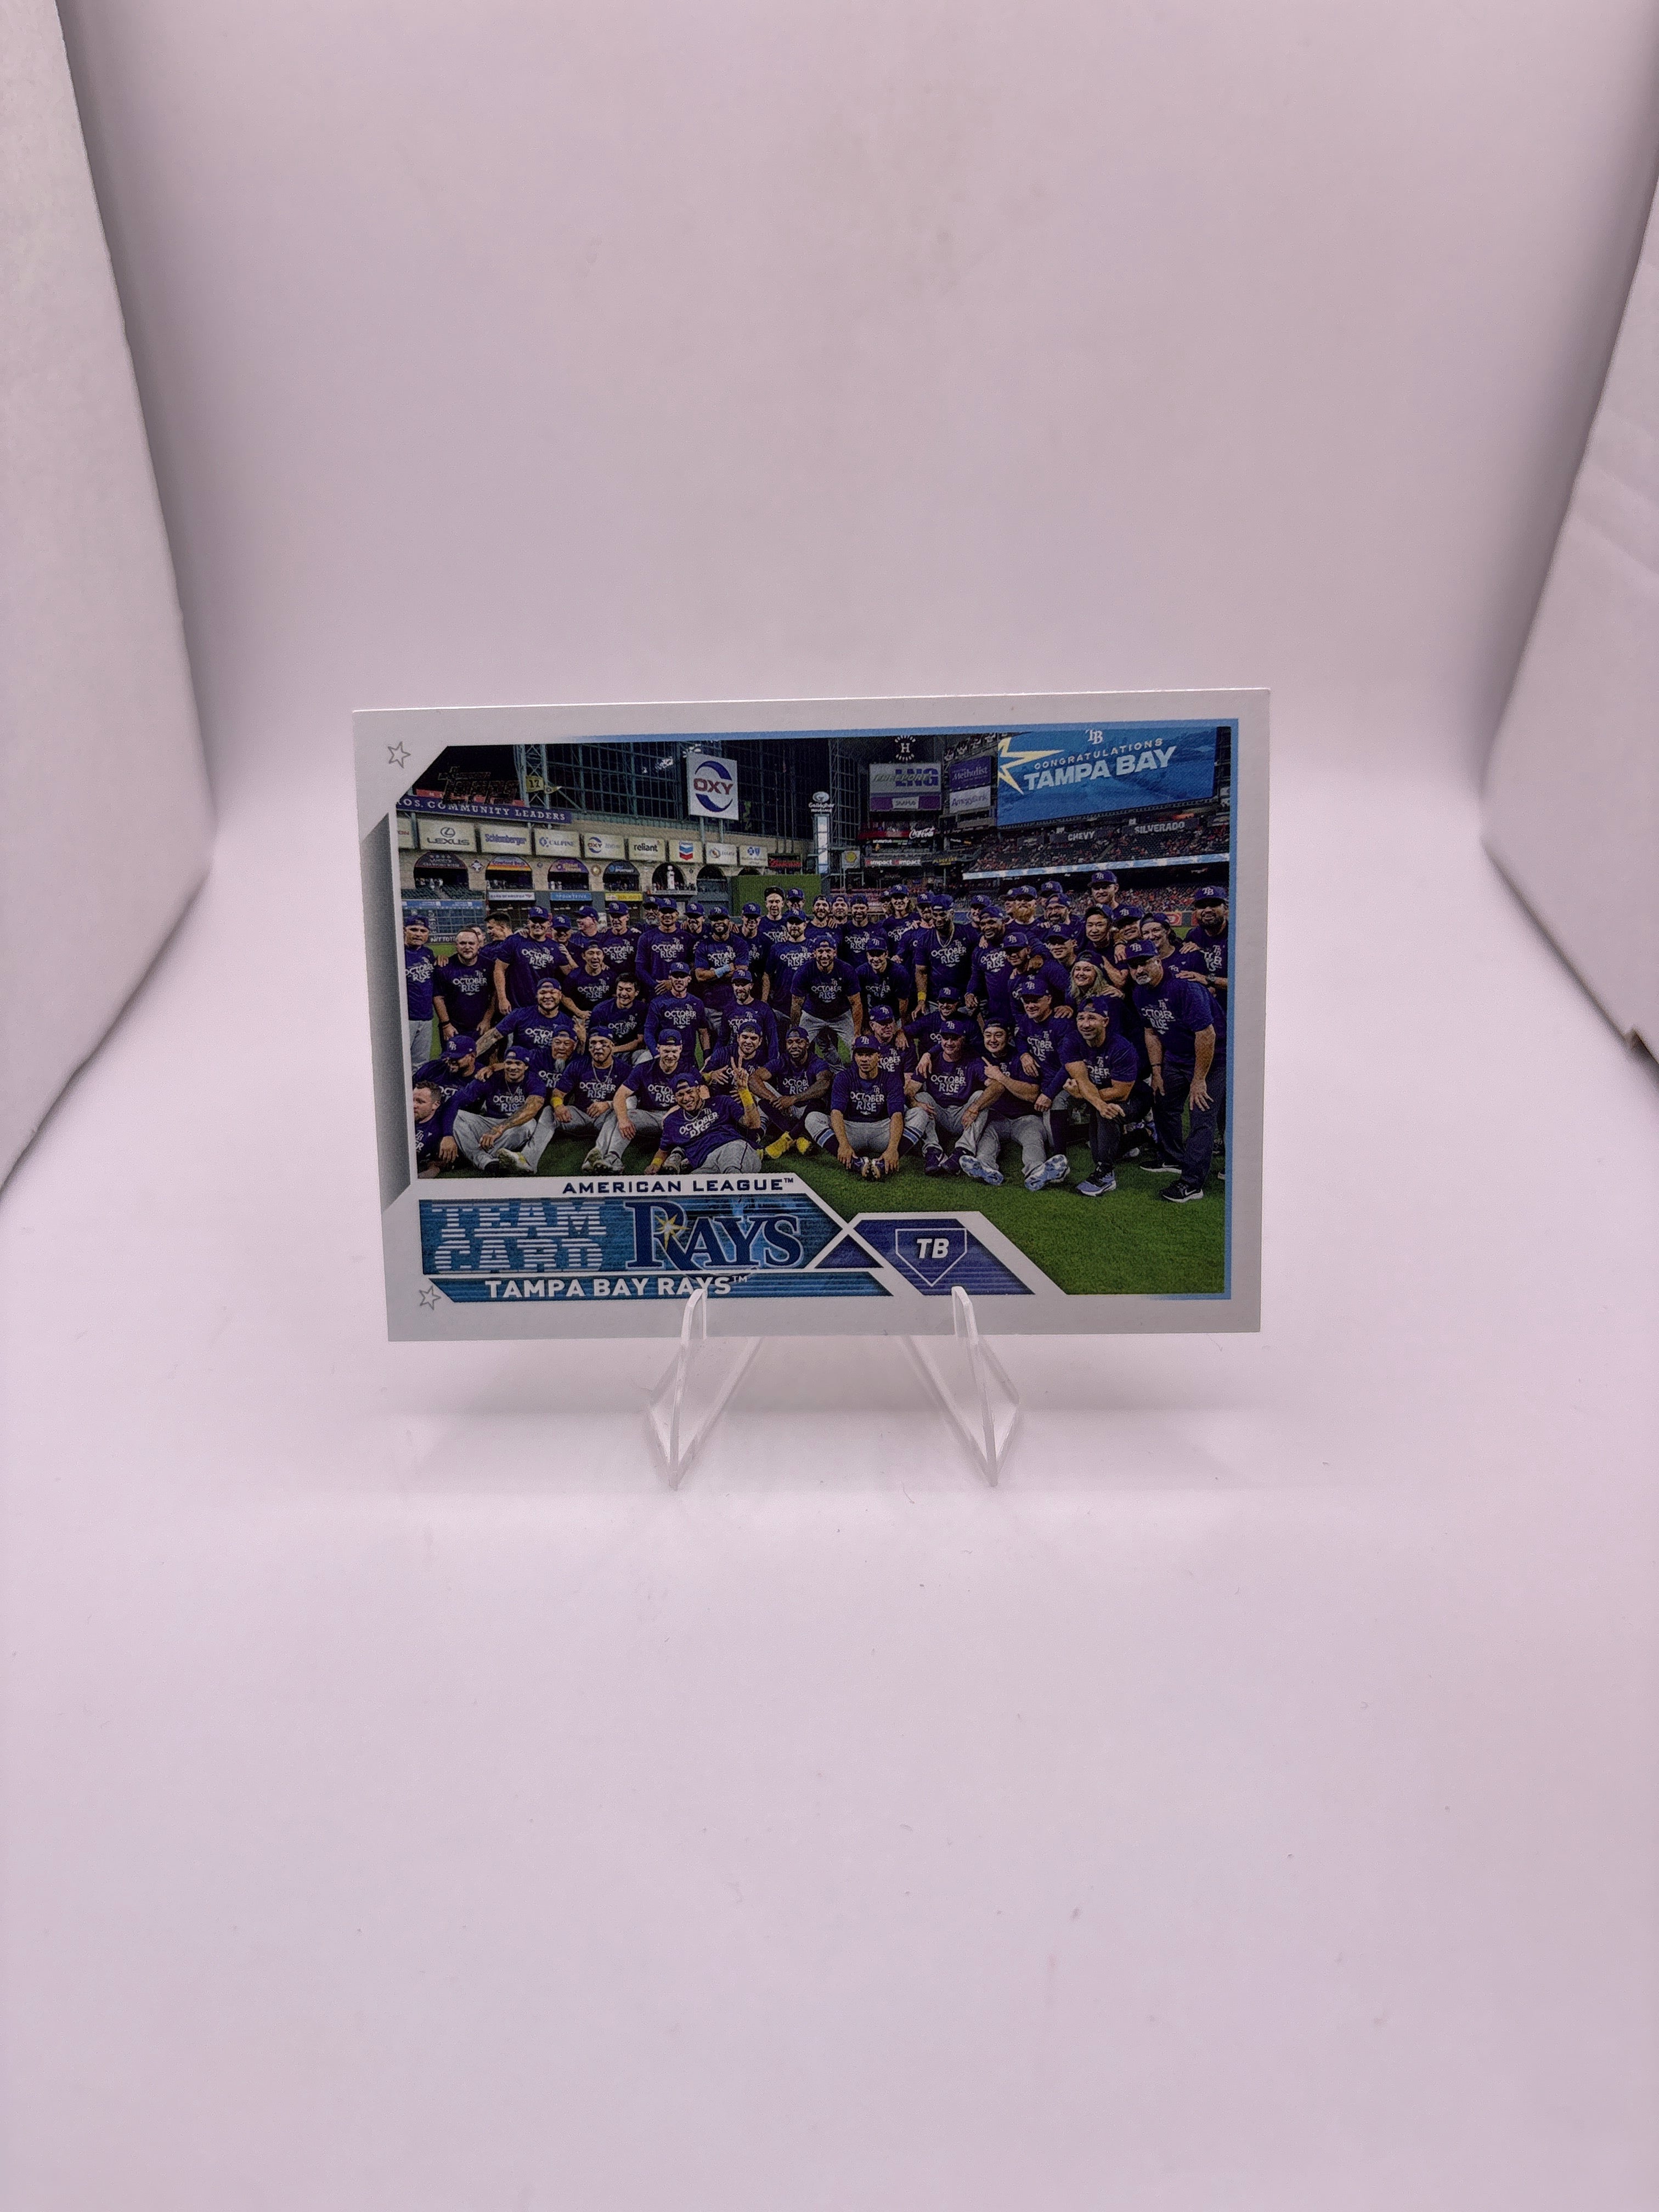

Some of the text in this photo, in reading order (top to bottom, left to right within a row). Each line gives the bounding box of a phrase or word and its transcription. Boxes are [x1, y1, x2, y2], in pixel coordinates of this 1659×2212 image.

[1034, 738, 1163, 770] CONGRATULATIONS
[1024, 746, 1177, 791] TAMPA BAY
[528, 778, 540, 788] 17
[693, 777, 734, 795] OXY
[427, 800, 510, 816] COMMUNITY
[515, 809, 566, 821] LEADERS
[1134, 821, 1185, 834] SILVERADO
[427, 837, 470, 846] LEXUS
[1068, 831, 1096, 842] CHEVY
[634, 843, 659, 852] reliant
[660, 950, 677, 958] RISE
[931, 947, 966, 957] OCTOBER
[529, 958, 547, 967] RISE
[940, 955, 960, 963] RISE
[986, 958, 1005, 970] RISE
[819, 991, 836, 999] RISE
[674, 1016, 691, 1025] RISE
[931, 1074, 966, 1084] OCTOBER
[579, 1082, 616, 1092] OCTOBER
[939, 1082, 960, 1093] RISE
[588, 1088, 606, 1098] RISE
[655, 1092, 675, 1103] RISE
[851, 1091, 885, 1103] OCTOBER
[856, 1102, 877, 1112] RISE
[679, 1111, 718, 1135] OCTOBER
[562, 1181, 681, 1194] AMERICAN
[432, 1201, 606, 1238] TEAM
[916, 1238, 950, 1260] TB
[435, 1238, 604, 1274] CARD
[485, 1278, 586, 1299] TAMPA
[593, 1278, 650, 1297] BAY
